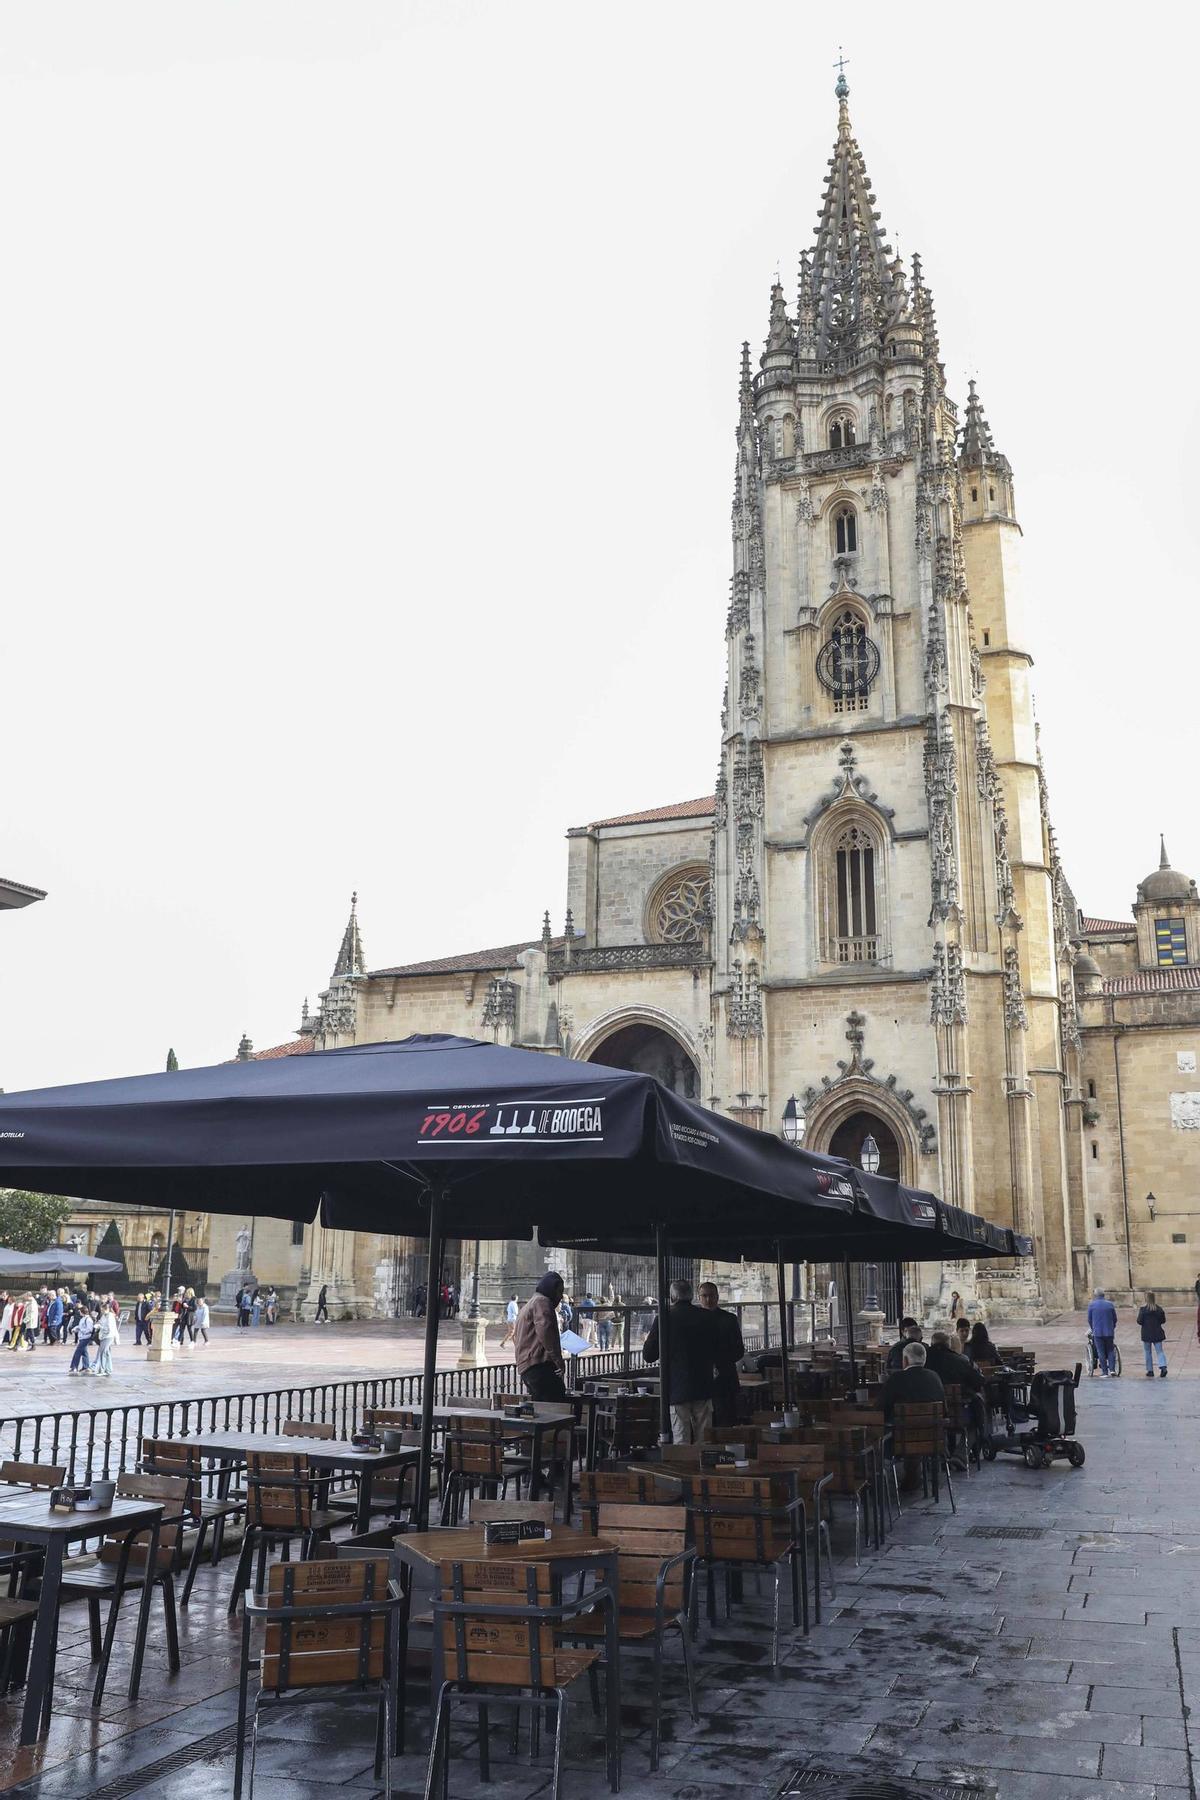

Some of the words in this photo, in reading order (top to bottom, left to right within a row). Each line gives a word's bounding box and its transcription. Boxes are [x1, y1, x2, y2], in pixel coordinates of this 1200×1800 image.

[419, 1109, 486, 1137] 1906
[538, 1109, 552, 1134] DE
[551, 1106, 602, 1133] BODEGA
